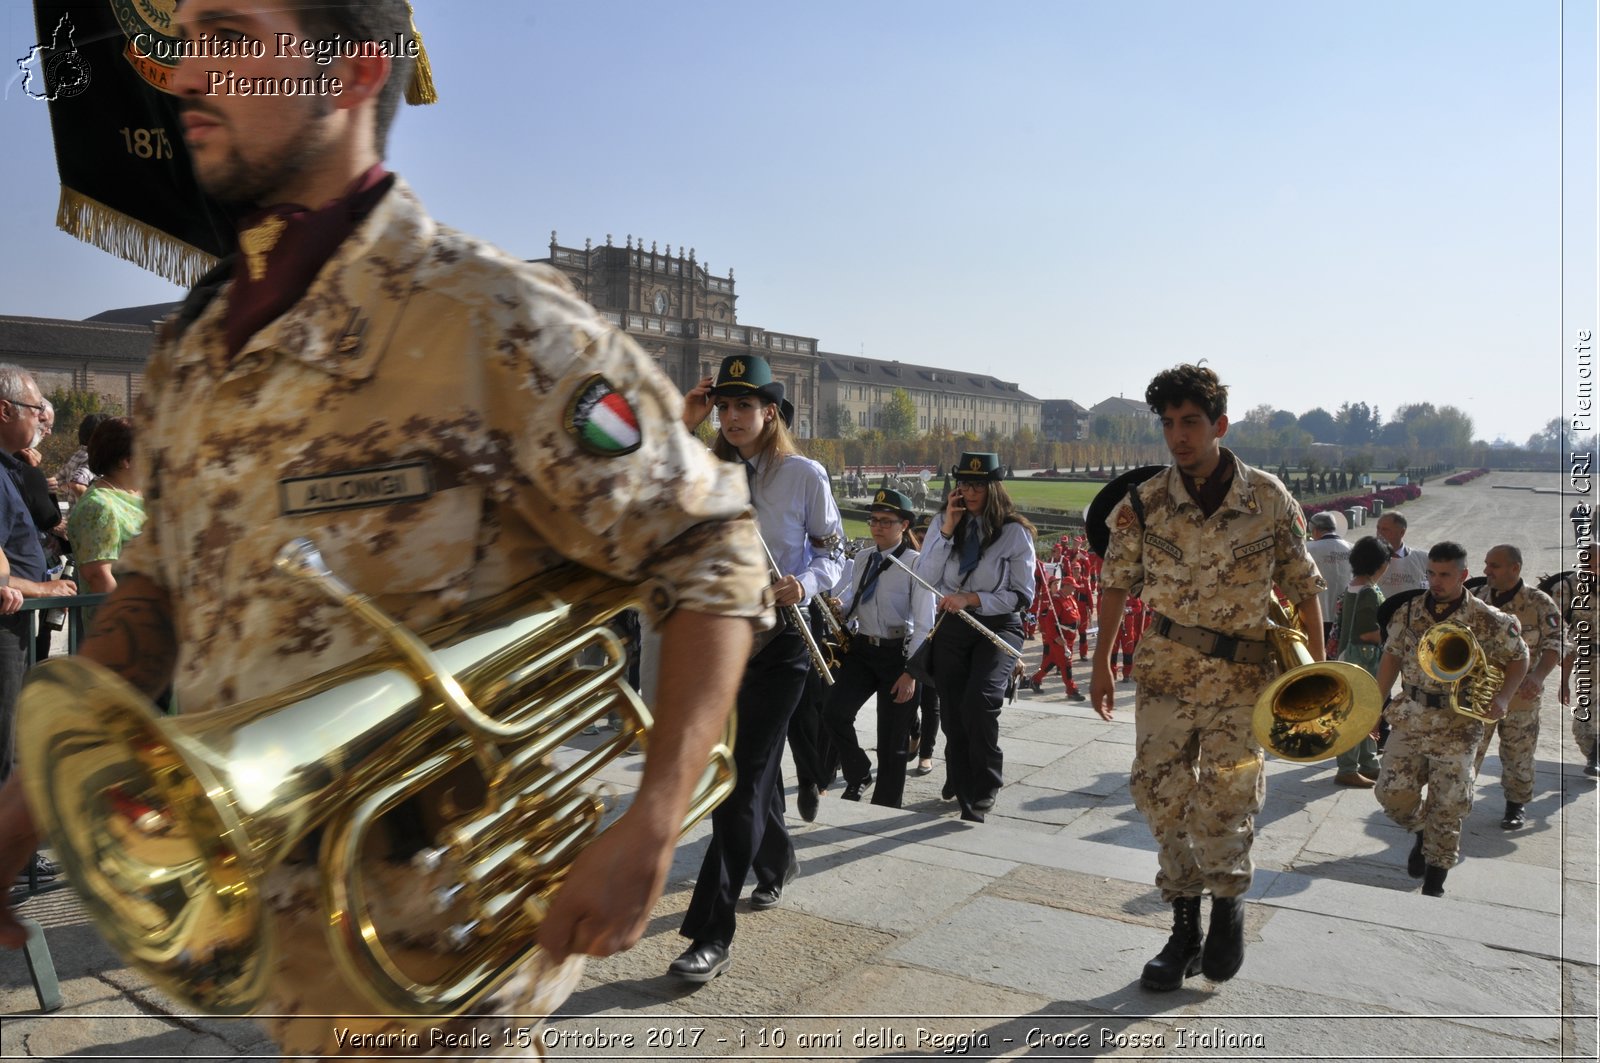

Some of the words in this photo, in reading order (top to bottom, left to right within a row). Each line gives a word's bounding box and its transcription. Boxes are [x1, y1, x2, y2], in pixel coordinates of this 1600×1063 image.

[119, 127, 173, 160] 1875
[1148, 536, 1179, 557] FANFARA
[1241, 540, 1268, 555] VOTO
